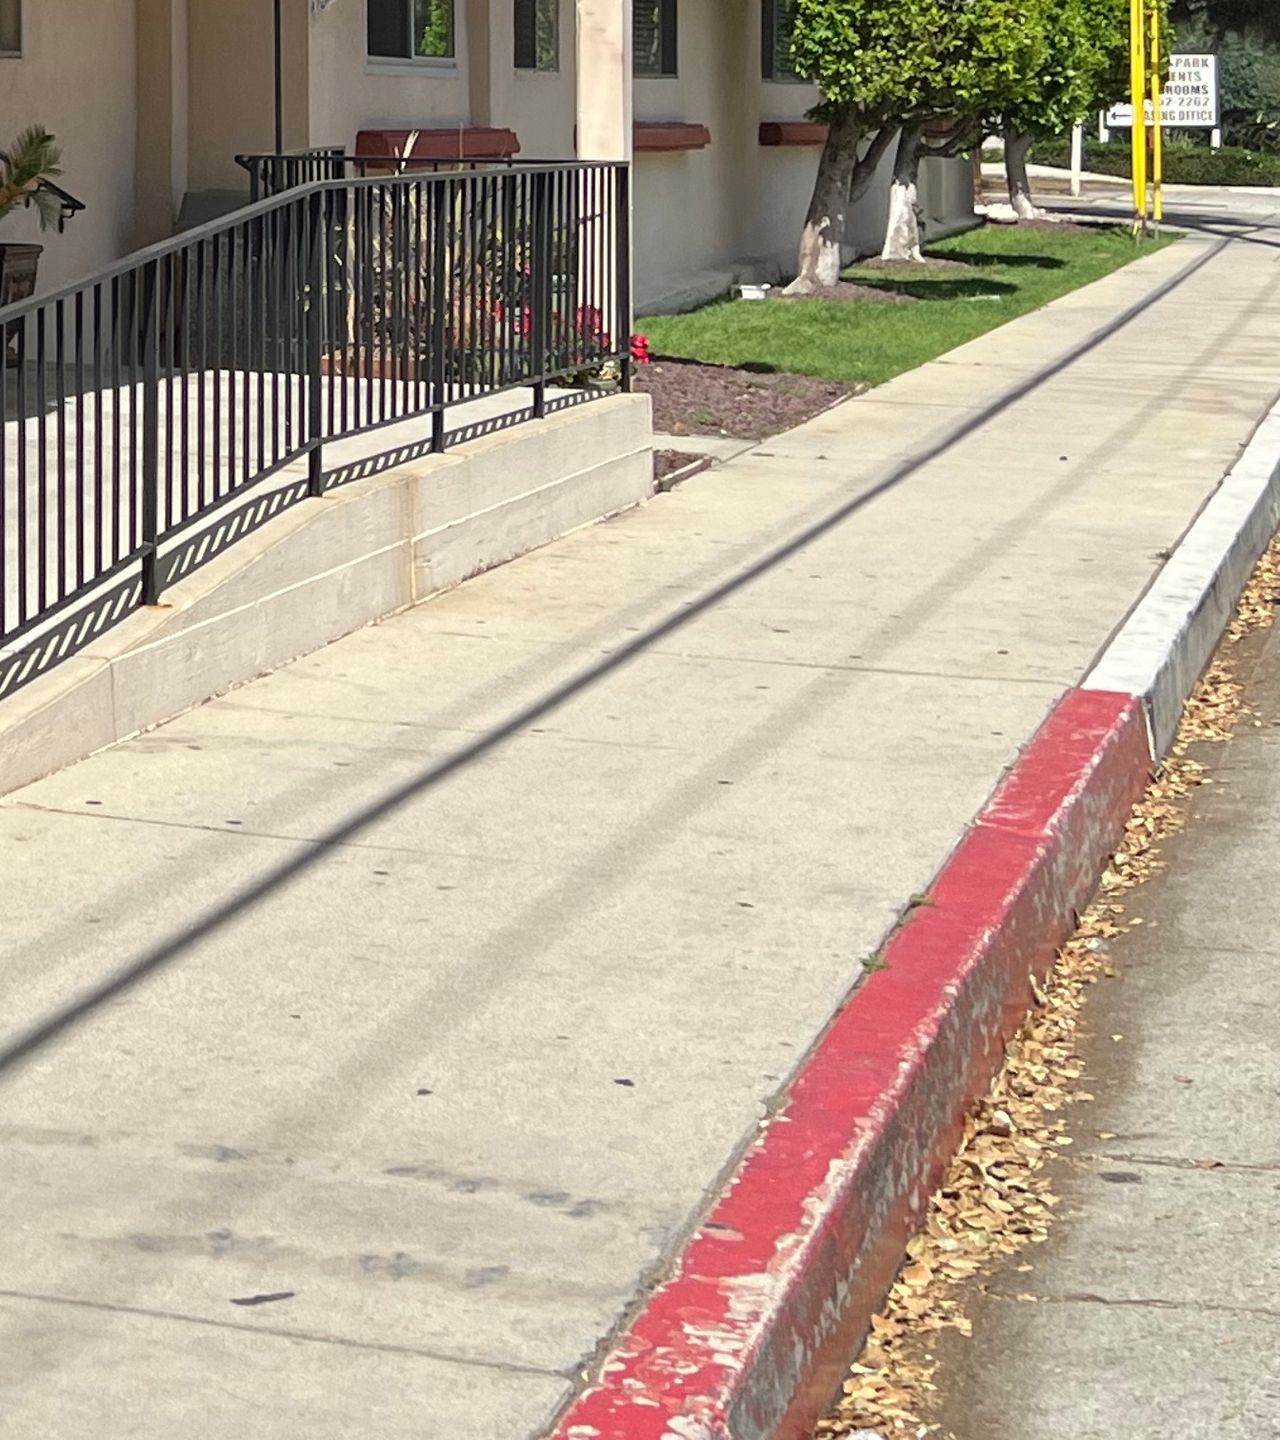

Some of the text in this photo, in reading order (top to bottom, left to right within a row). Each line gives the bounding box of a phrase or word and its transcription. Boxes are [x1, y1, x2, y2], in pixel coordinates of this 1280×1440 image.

[1175, 58, 1209, 68] PARK
[1169, 71, 1202, 82] ENTS
[1165, 85, 1209, 95] ROOMS
